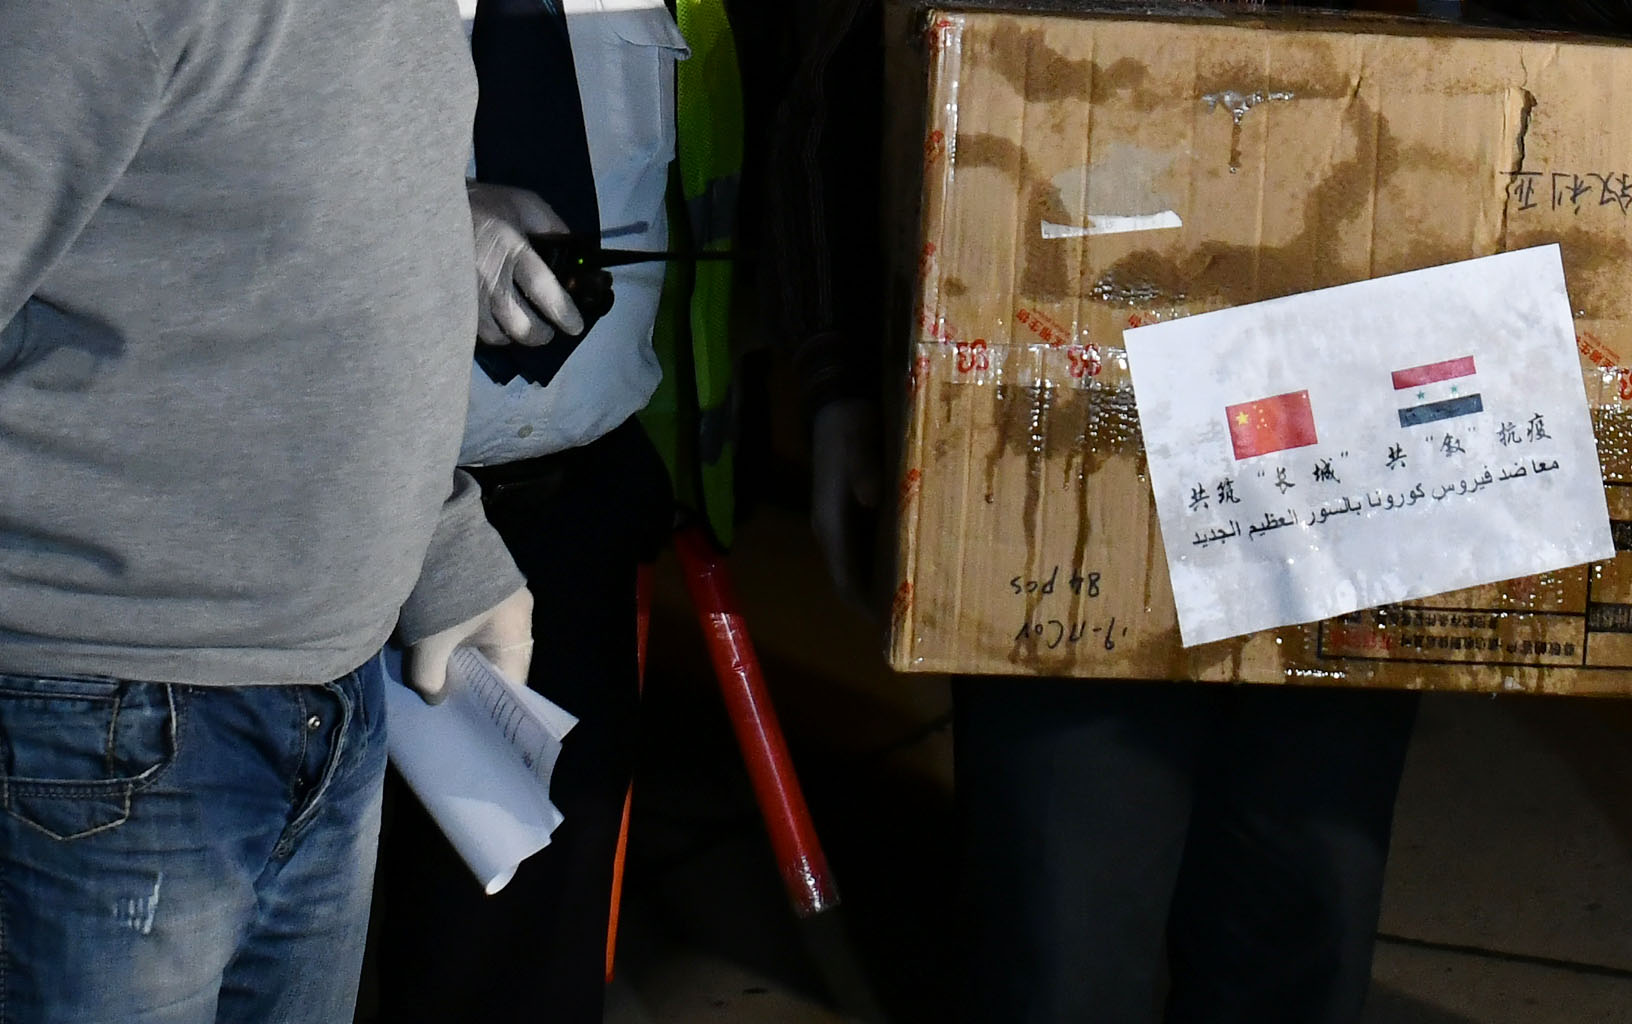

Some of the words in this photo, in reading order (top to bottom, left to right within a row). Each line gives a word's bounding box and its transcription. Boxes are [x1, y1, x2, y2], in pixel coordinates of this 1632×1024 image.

[1365, 483, 1425, 510] كورونا
[1432, 465, 1493, 500] فيروس
[1248, 509, 1298, 541] العظيم
[1307, 496, 1362, 526] بالسور
[1192, 520, 1241, 549] الجديد
